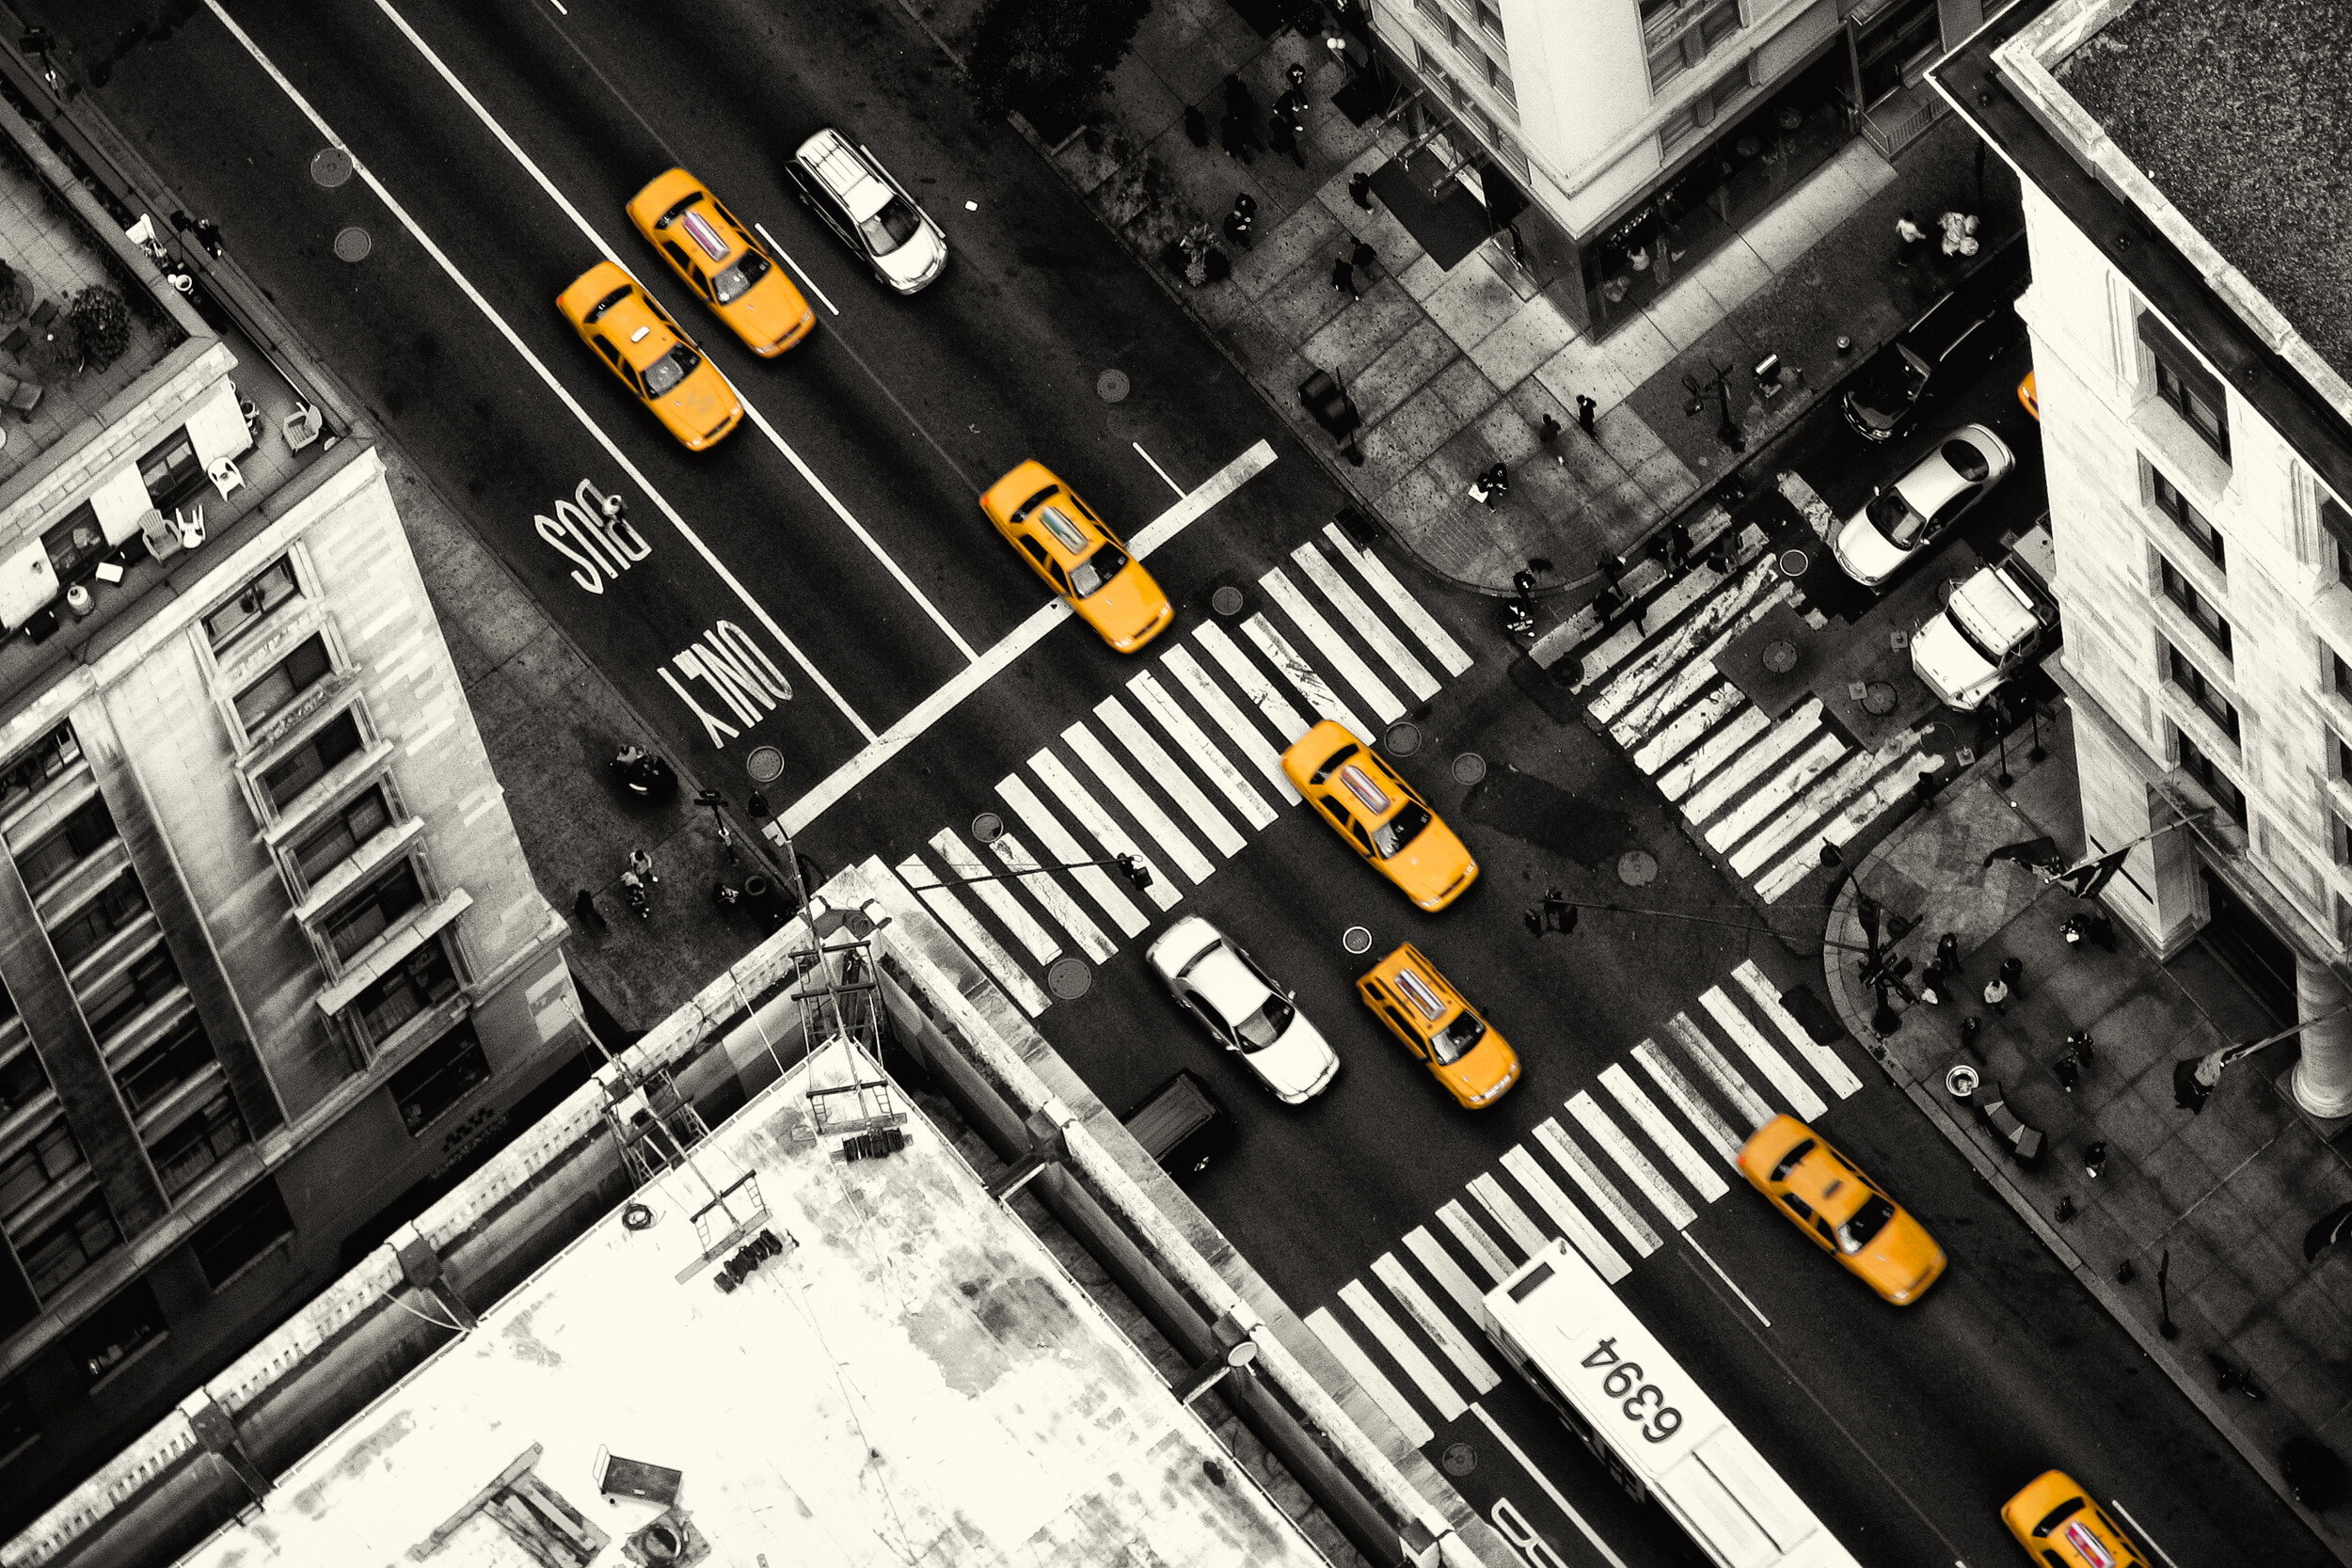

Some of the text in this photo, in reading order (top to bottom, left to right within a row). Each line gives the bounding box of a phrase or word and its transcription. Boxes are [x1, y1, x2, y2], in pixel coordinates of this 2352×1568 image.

[533, 478, 653, 594] BUS
[657, 620, 794, 750] ONLY
[1581, 1336, 1683, 1444] 6394
